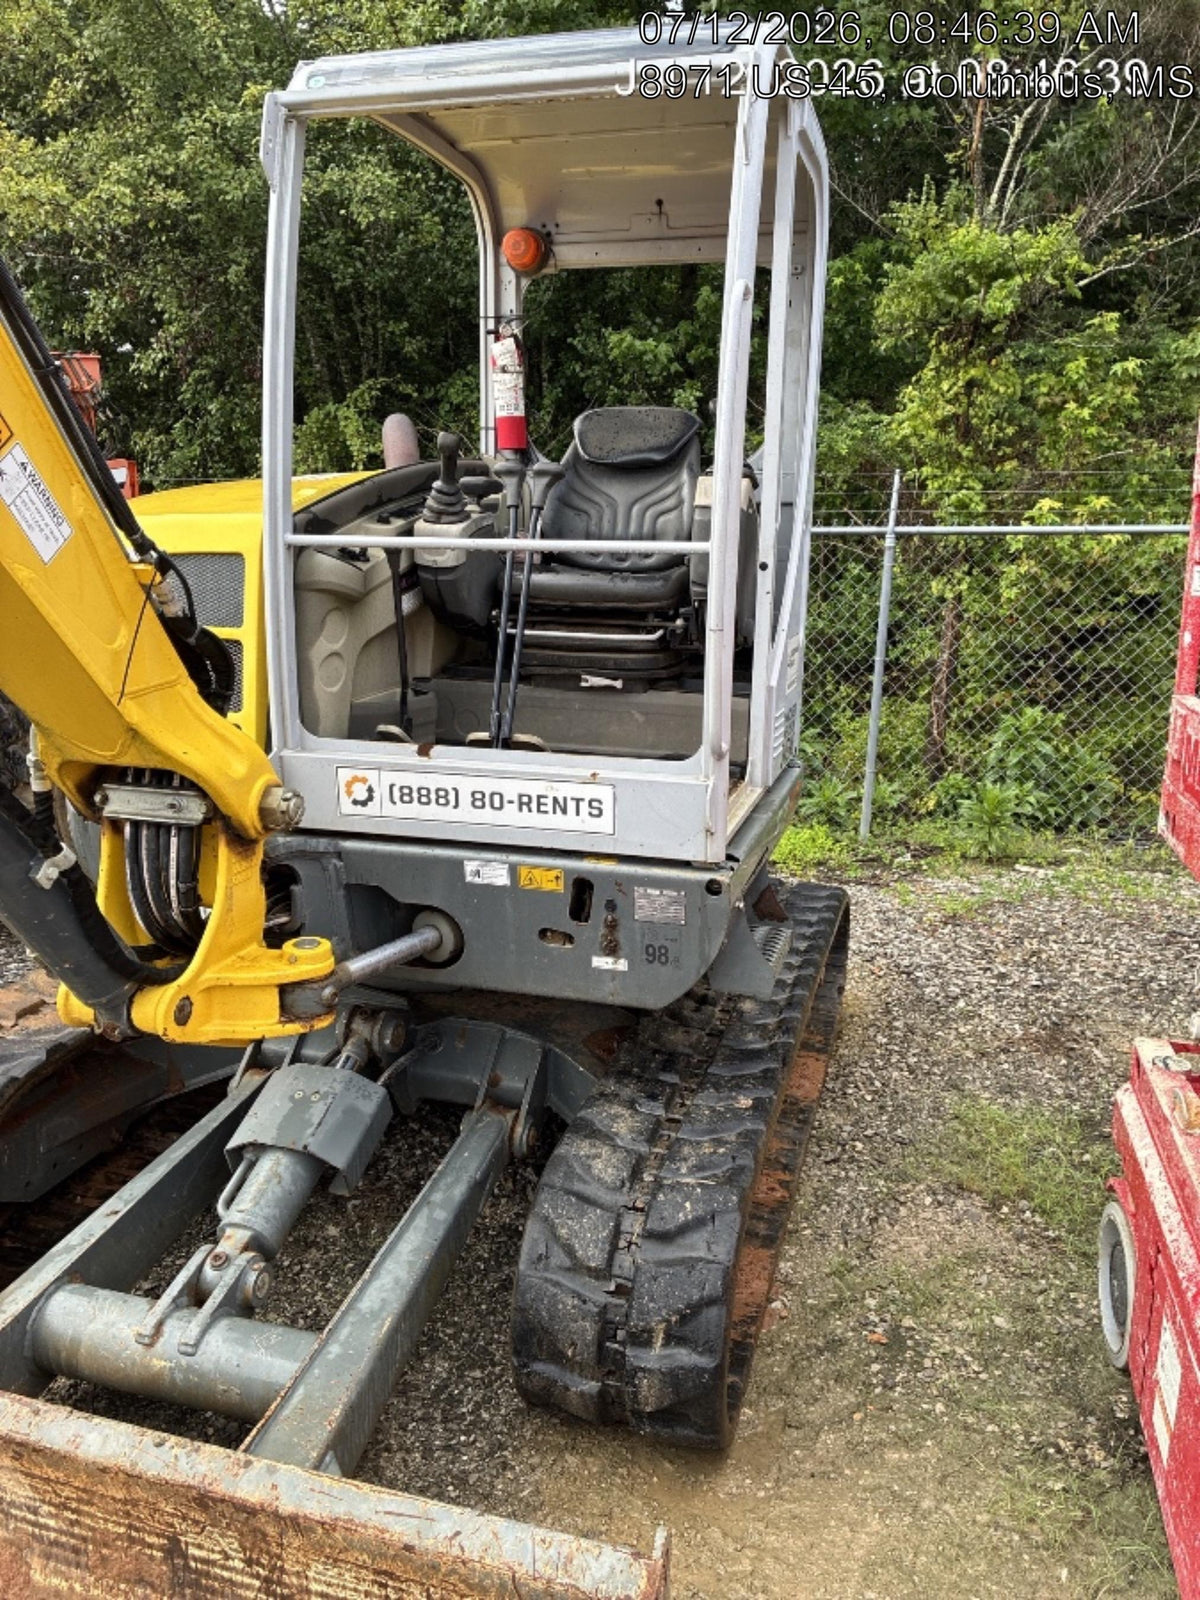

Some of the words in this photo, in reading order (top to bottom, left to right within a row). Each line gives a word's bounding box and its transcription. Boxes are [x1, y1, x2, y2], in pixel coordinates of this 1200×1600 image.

[27, 470, 66, 528] WARNING
[388, 783, 460, 809] (888)
[470, 790, 604, 818] 80-RENTS
[644, 943, 670, 967] 98
